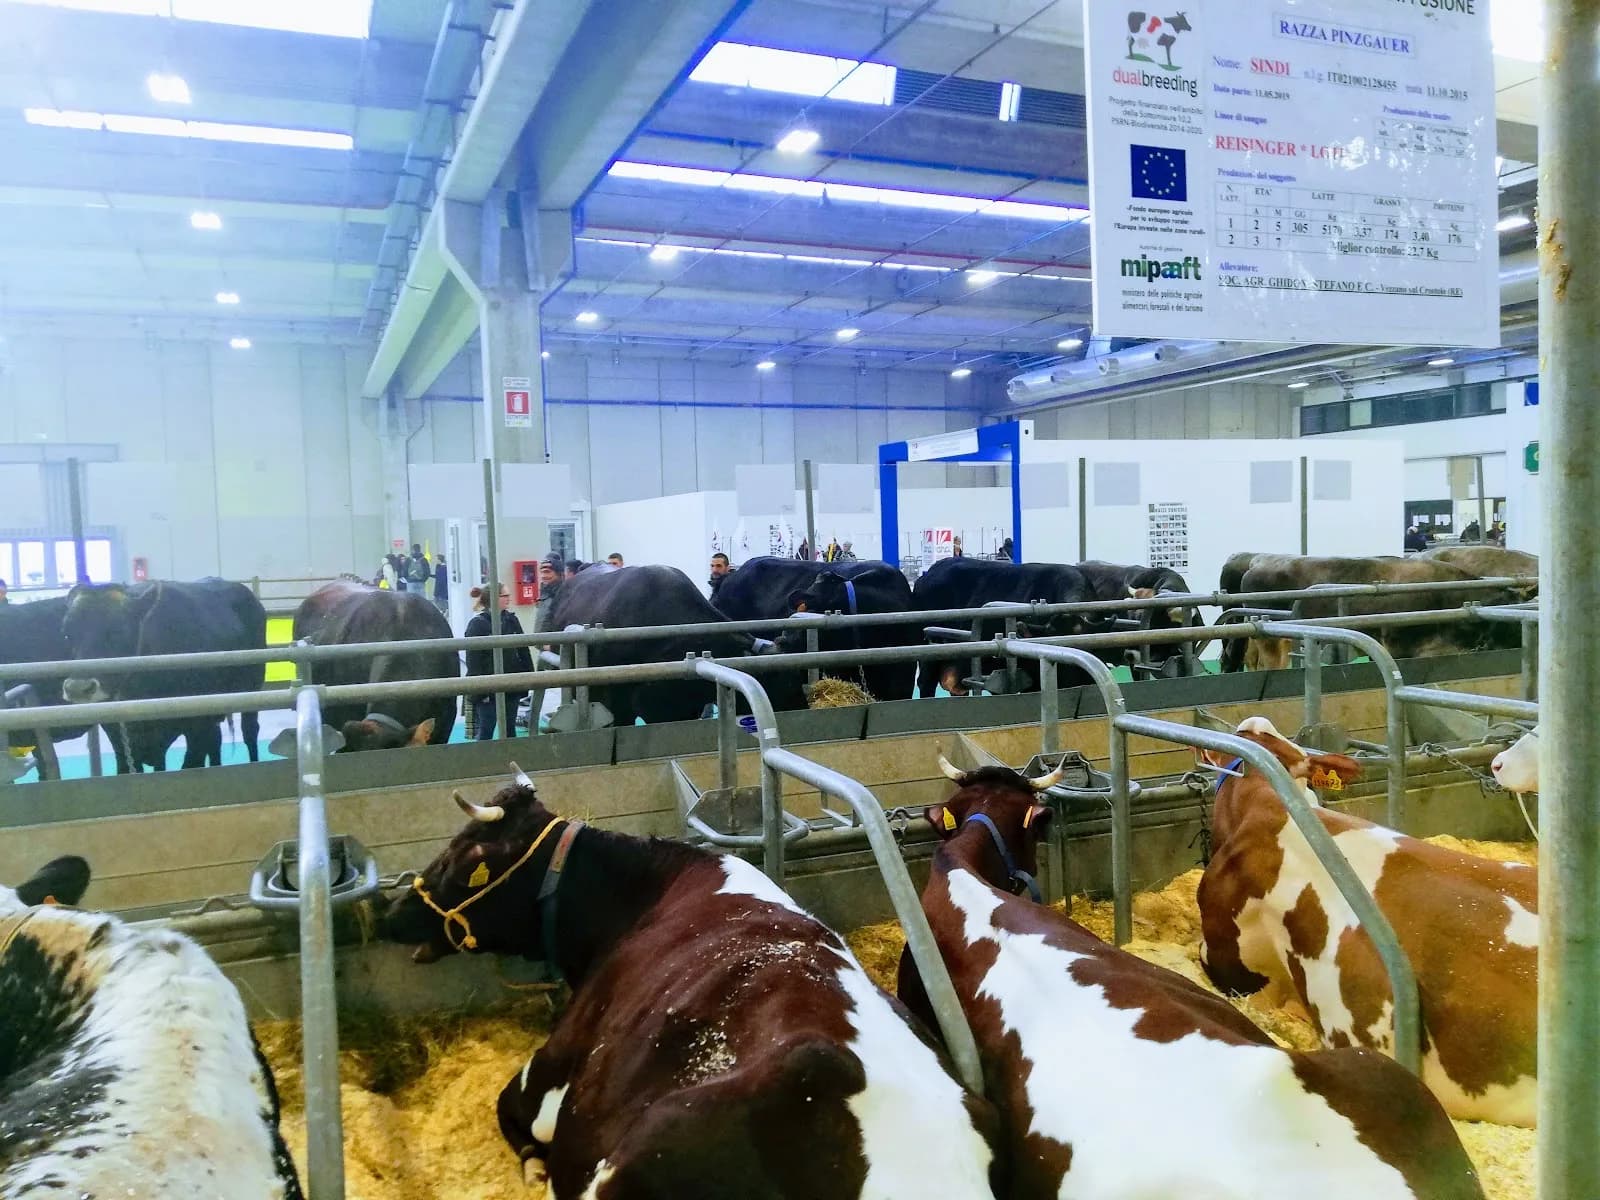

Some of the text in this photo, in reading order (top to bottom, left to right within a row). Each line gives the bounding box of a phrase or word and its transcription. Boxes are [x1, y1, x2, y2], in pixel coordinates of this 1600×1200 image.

[1280, 19, 1410, 53] RAZZA PINZGAUER
[1250, 57, 1290, 76] SINDI
[1113, 66, 1198, 98] dualbreeding
[1215, 135, 1297, 156] REISINGER
[1311, 192, 1336, 201] LATTE
[1253, 219, 1260, 230] 2
[1275, 221, 1281, 232] 5
[1291, 222, 1309, 234] 305
[1384, 229, 1399, 240] 174
[1228, 234, 1234, 245] 2
[1253, 235, 1260, 246] 3
[1275, 237, 1282, 248] 7
[1426, 247, 1439, 261] Kg
[1121, 254, 1202, 283] mipaaft
[1268, 277, 1309, 289] GHIDON
[1312, 279, 1355, 290] STEFANO
